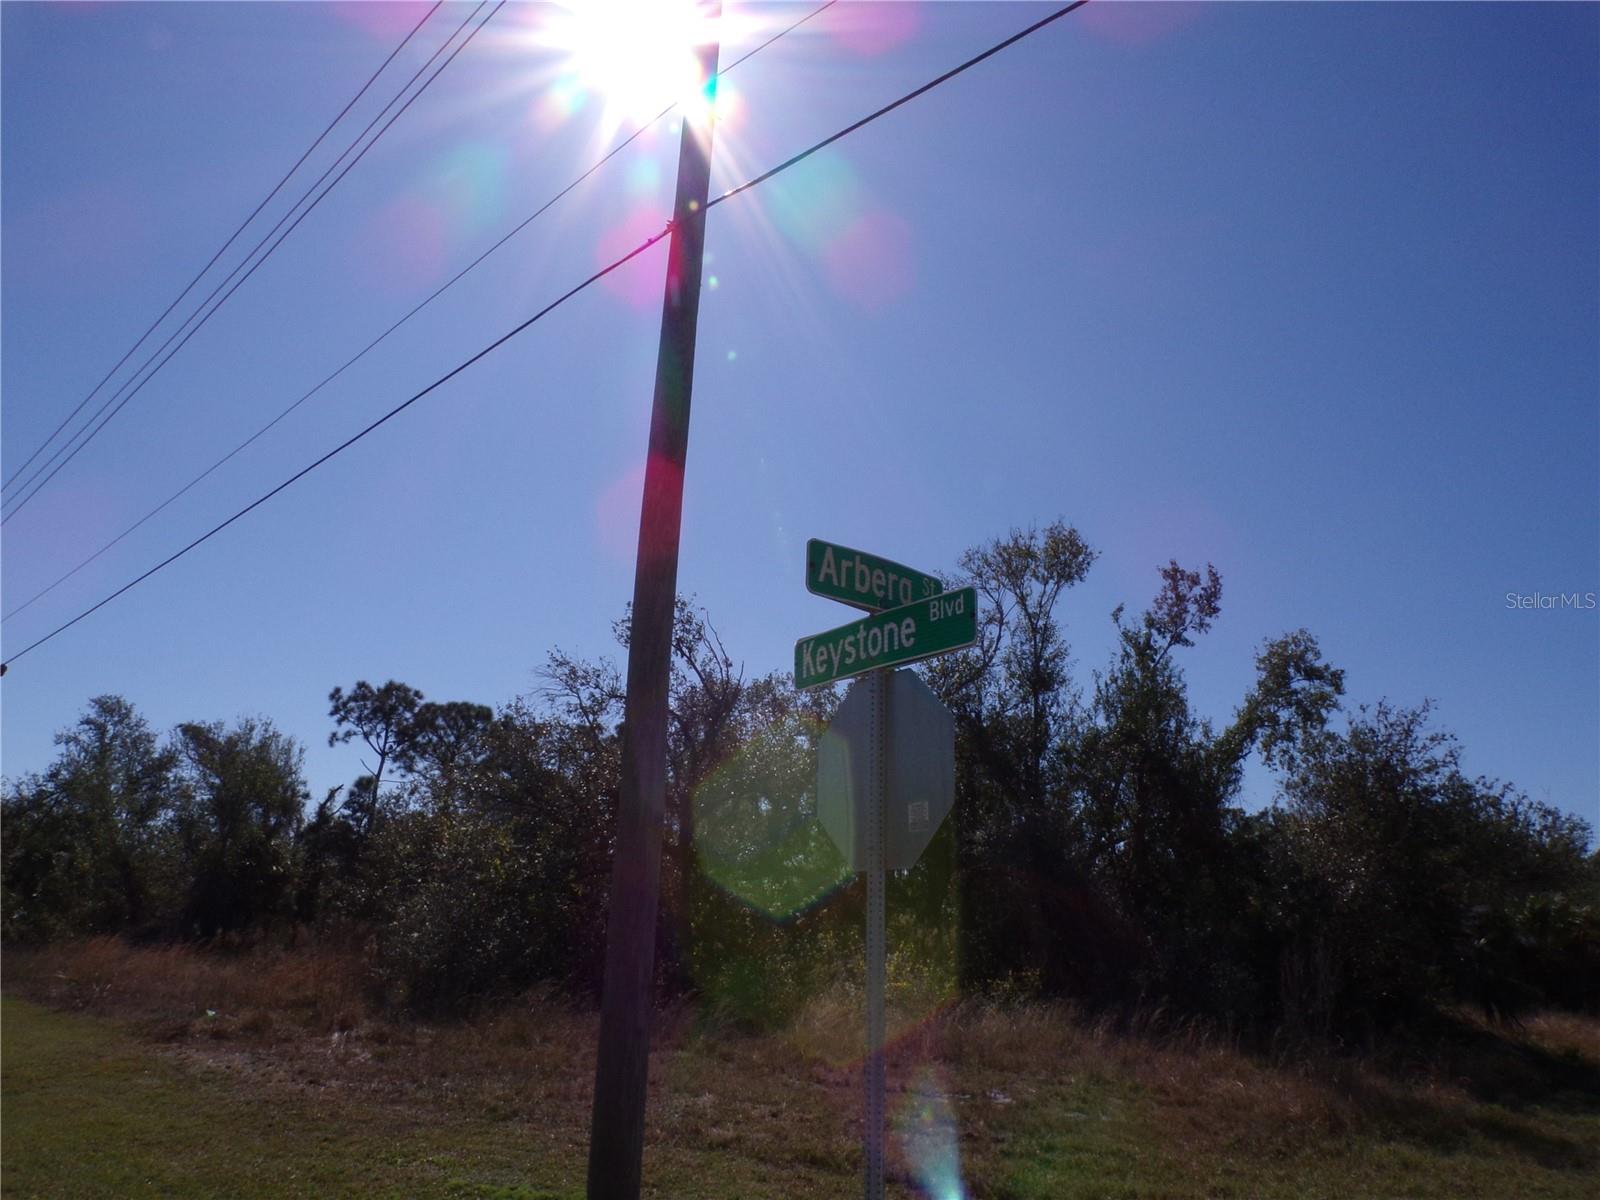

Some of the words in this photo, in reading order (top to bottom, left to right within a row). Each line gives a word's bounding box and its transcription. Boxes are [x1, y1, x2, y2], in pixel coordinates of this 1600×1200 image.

[922, 577, 936, 597] St
[801, 616, 917, 679] Keystone
[929, 594, 965, 622] Blvd
